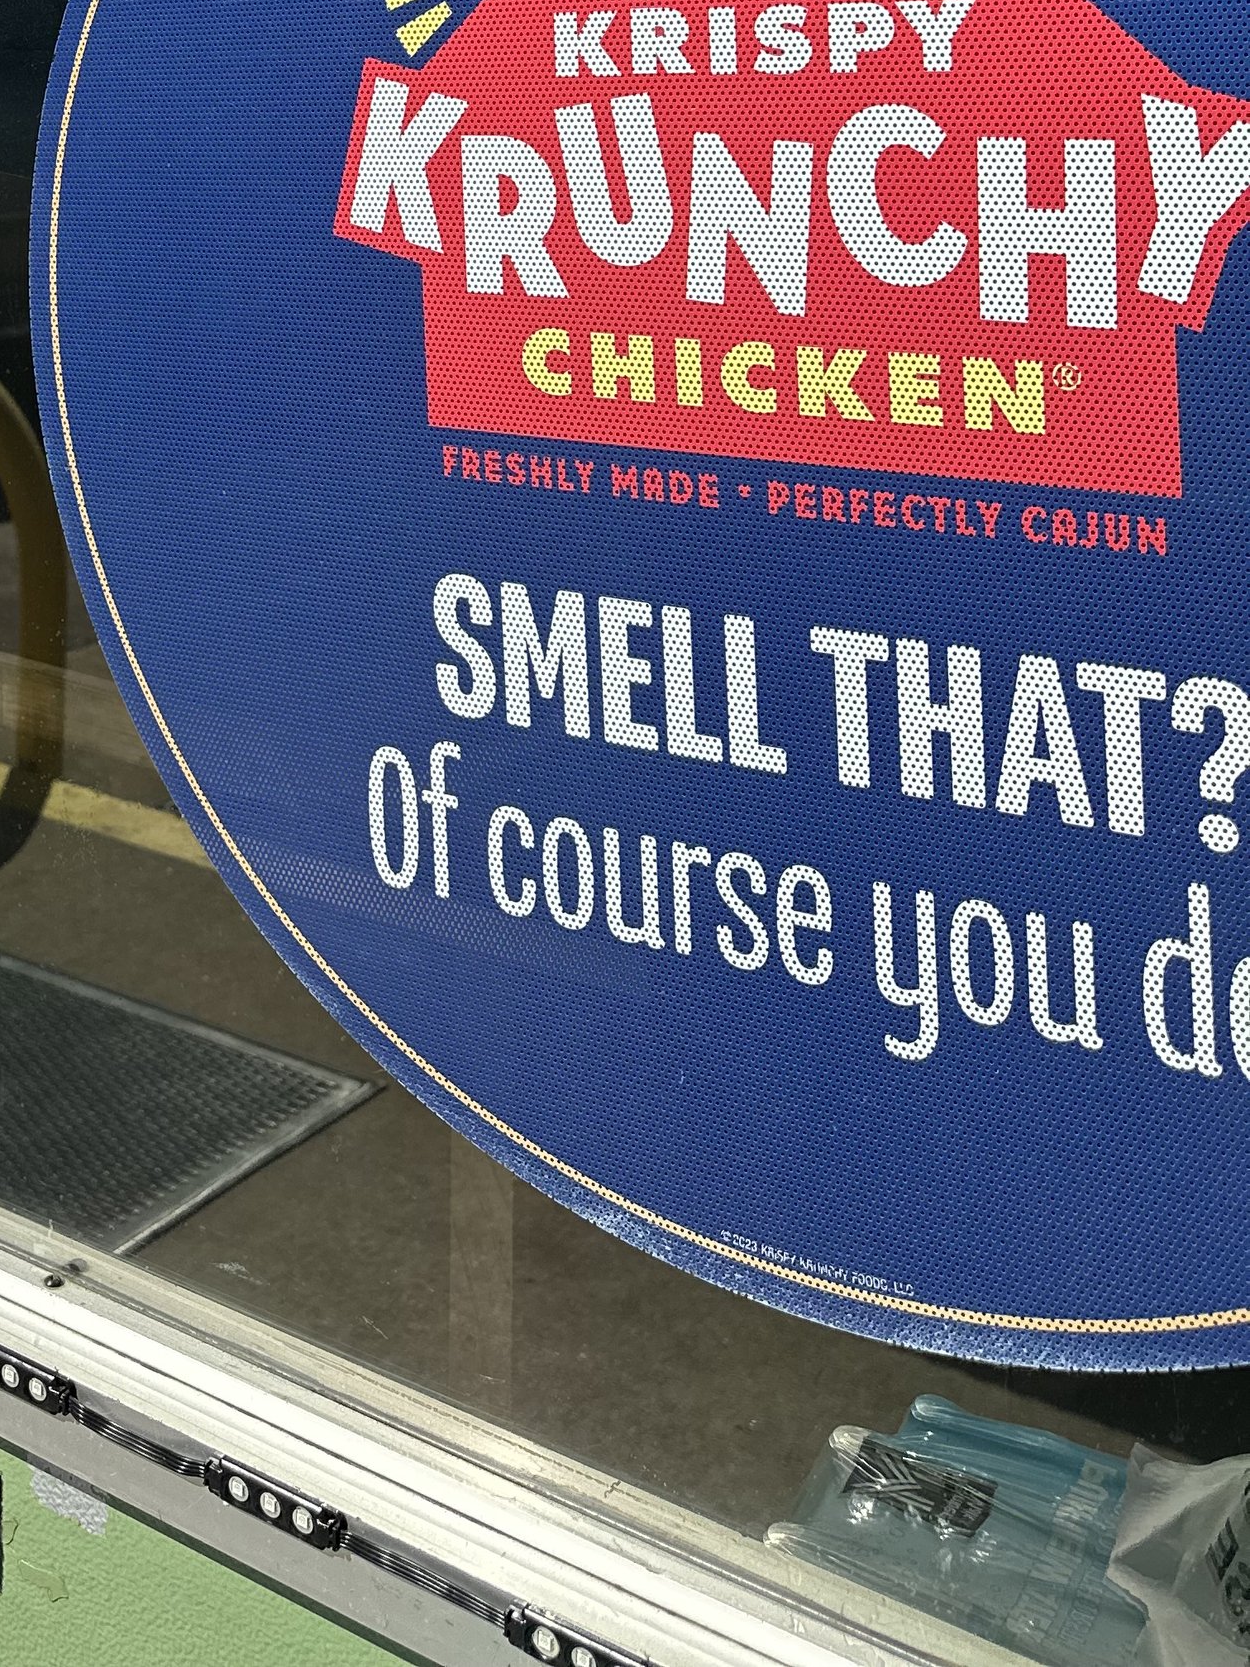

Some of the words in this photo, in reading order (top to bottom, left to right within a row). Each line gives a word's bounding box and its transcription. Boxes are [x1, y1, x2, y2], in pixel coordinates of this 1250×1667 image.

[349, 75, 1250, 331] KRUNCHY
[442, 444, 595, 494] FRESHLY
[610, 463, 720, 509] MADE
[766, 479, 1003, 539] PERFECTLY
[1020, 504, 1168, 557] CAJUN
[520, 325, 1047, 435] CHICKEN
[432, 573, 788, 775] SMELL
[810, 624, 1250, 855] THAT?
[367, 740, 462, 900] Of
[487, 804, 835, 987] course
[870, 878, 1105, 1063] you
